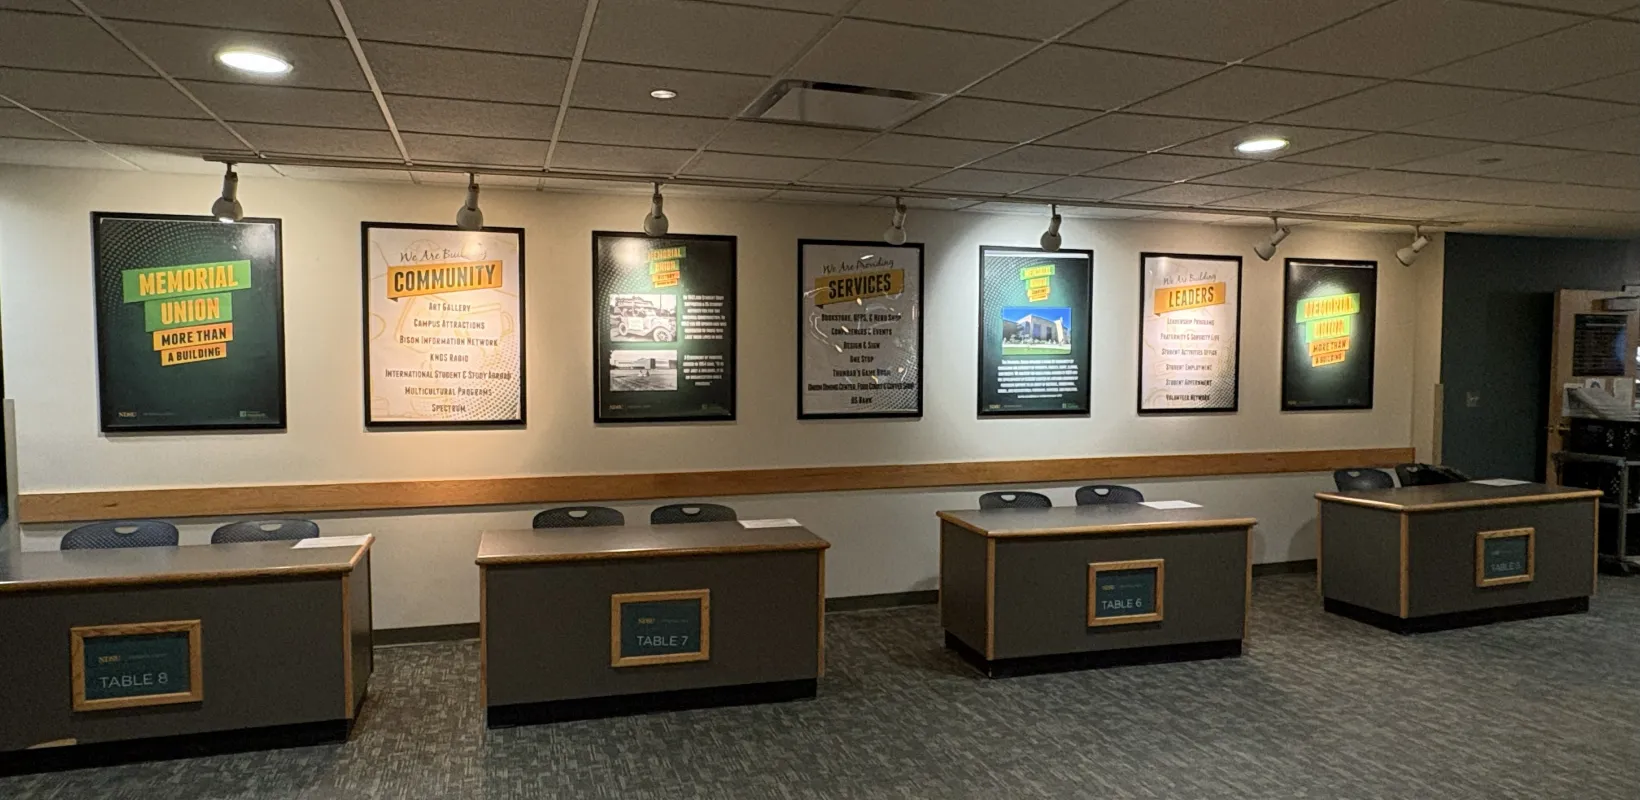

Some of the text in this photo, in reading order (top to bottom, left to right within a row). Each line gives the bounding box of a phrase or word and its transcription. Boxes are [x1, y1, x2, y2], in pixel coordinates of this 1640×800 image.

[400, 251, 417, 263] We
[420, 249, 441, 262] Are
[822, 257, 894, 274] We Are Providing
[139, 264, 238, 297] MEMORIAL
[394, 264, 496, 292] COMMUNITY
[828, 273, 891, 299] SERVICES
[1168, 285, 1214, 308] LEADERS
[161, 297, 220, 325] UNION
[428, 302, 471, 312] ART GALLERY
[1304, 297, 1353, 318] MEMORIAL
[413, 318, 485, 330] CAMPUS ATTRACTIONS
[1314, 318, 1344, 337] UNION
[161, 327, 227, 347] MORE THAN
[872, 328, 892, 336] EVENTS
[399, 335, 498, 346] BISON INFORMATION NETWORK
[843, 341, 862, 349] DESIGN
[868, 341, 880, 349] SIGN
[1312, 339, 1347, 353] MORE THAN
[168, 346, 221, 363] A BUILDING
[449, 354, 469, 363] RADIO
[850, 355, 874, 363] ONE STOP
[1320, 353, 1342, 363] BUILDING
[385, 368, 512, 380] INTERNATIONAL STUDENT & STUDY ABROAD
[862, 369, 876, 377] GAME
[405, 386, 492, 396] MULTICULTURAL PROGRAMS
[859, 396, 873, 404] BANK
[431, 403, 466, 413] SPECTRUM
[1490, 562, 1516, 571] TABLE
[1101, 598, 1142, 610] TABLE 6
[636, 635, 689, 647] TABLE 7
[99, 672, 169, 688] TABLE 8
